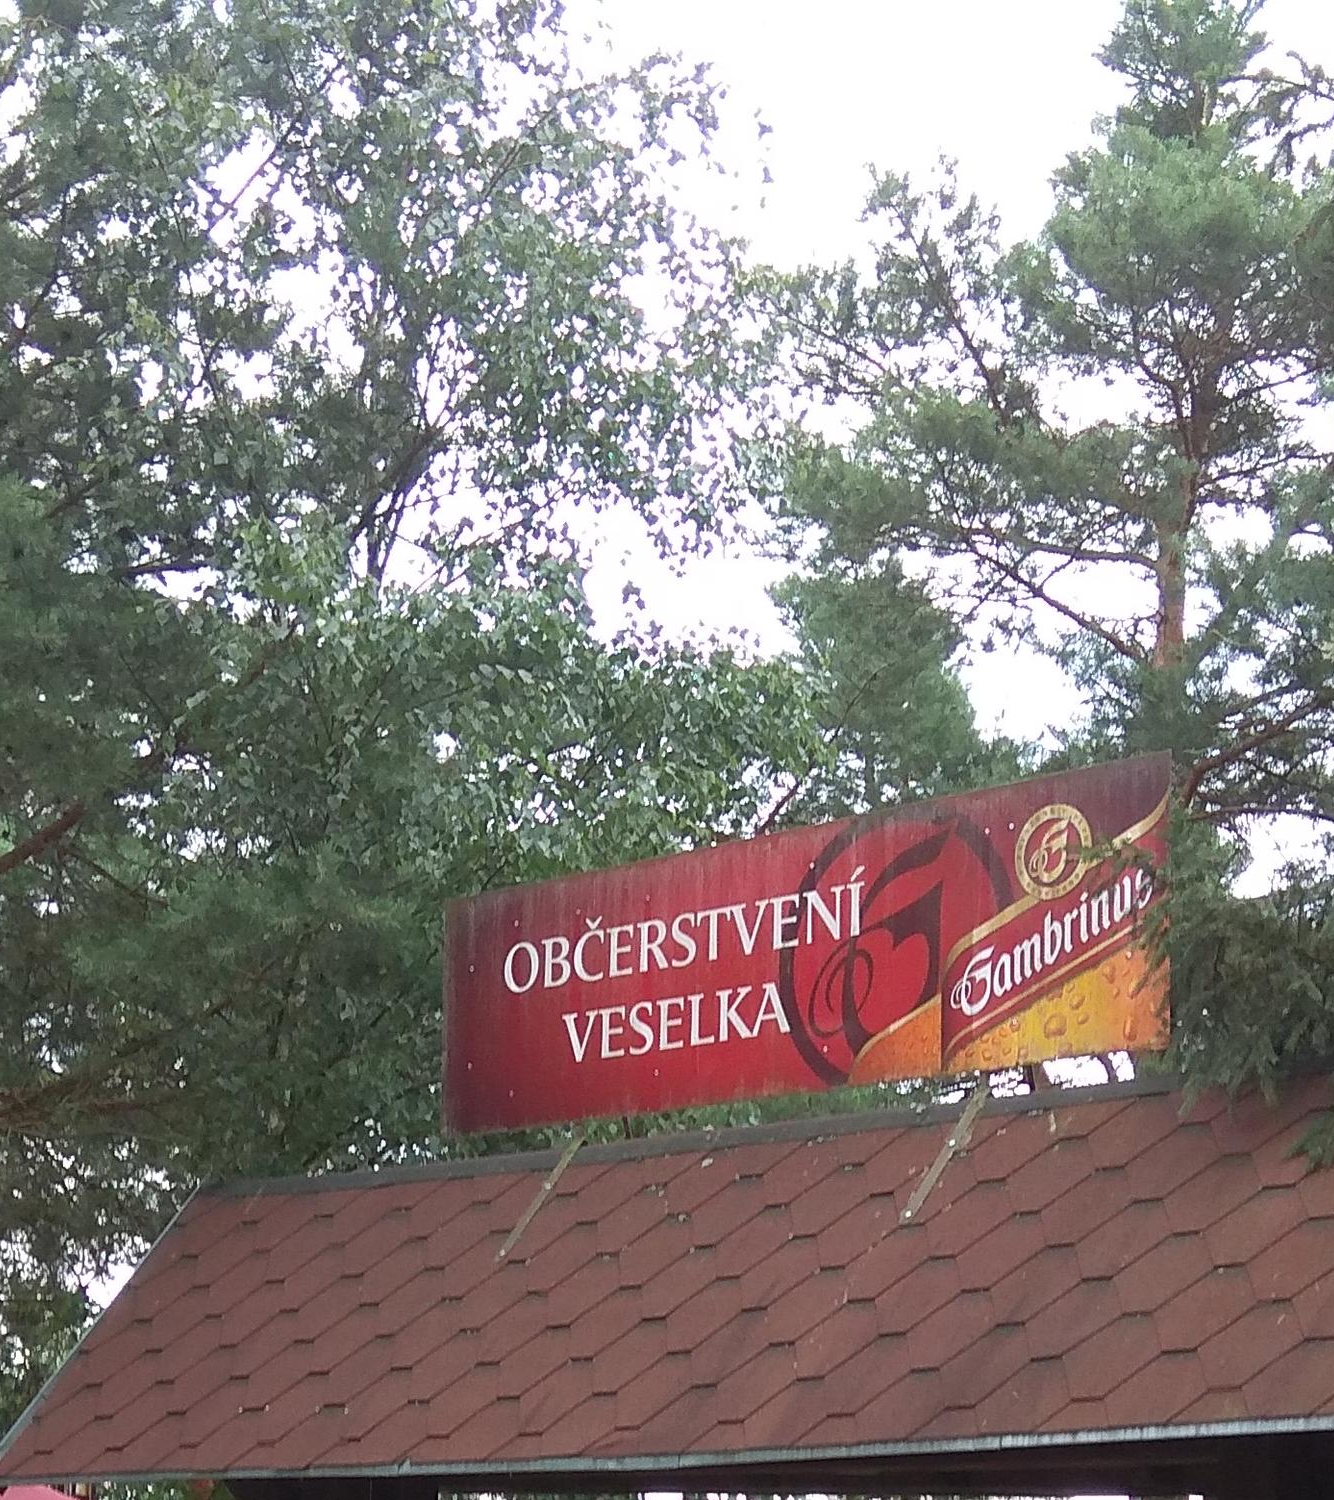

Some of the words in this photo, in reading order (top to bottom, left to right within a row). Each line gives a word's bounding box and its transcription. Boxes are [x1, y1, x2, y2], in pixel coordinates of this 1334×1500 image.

[503, 865, 866, 994] OBČERSTVENÍ
[950, 867, 1154, 1017] Gambrinus
[562, 981, 791, 1063] VESELKA
